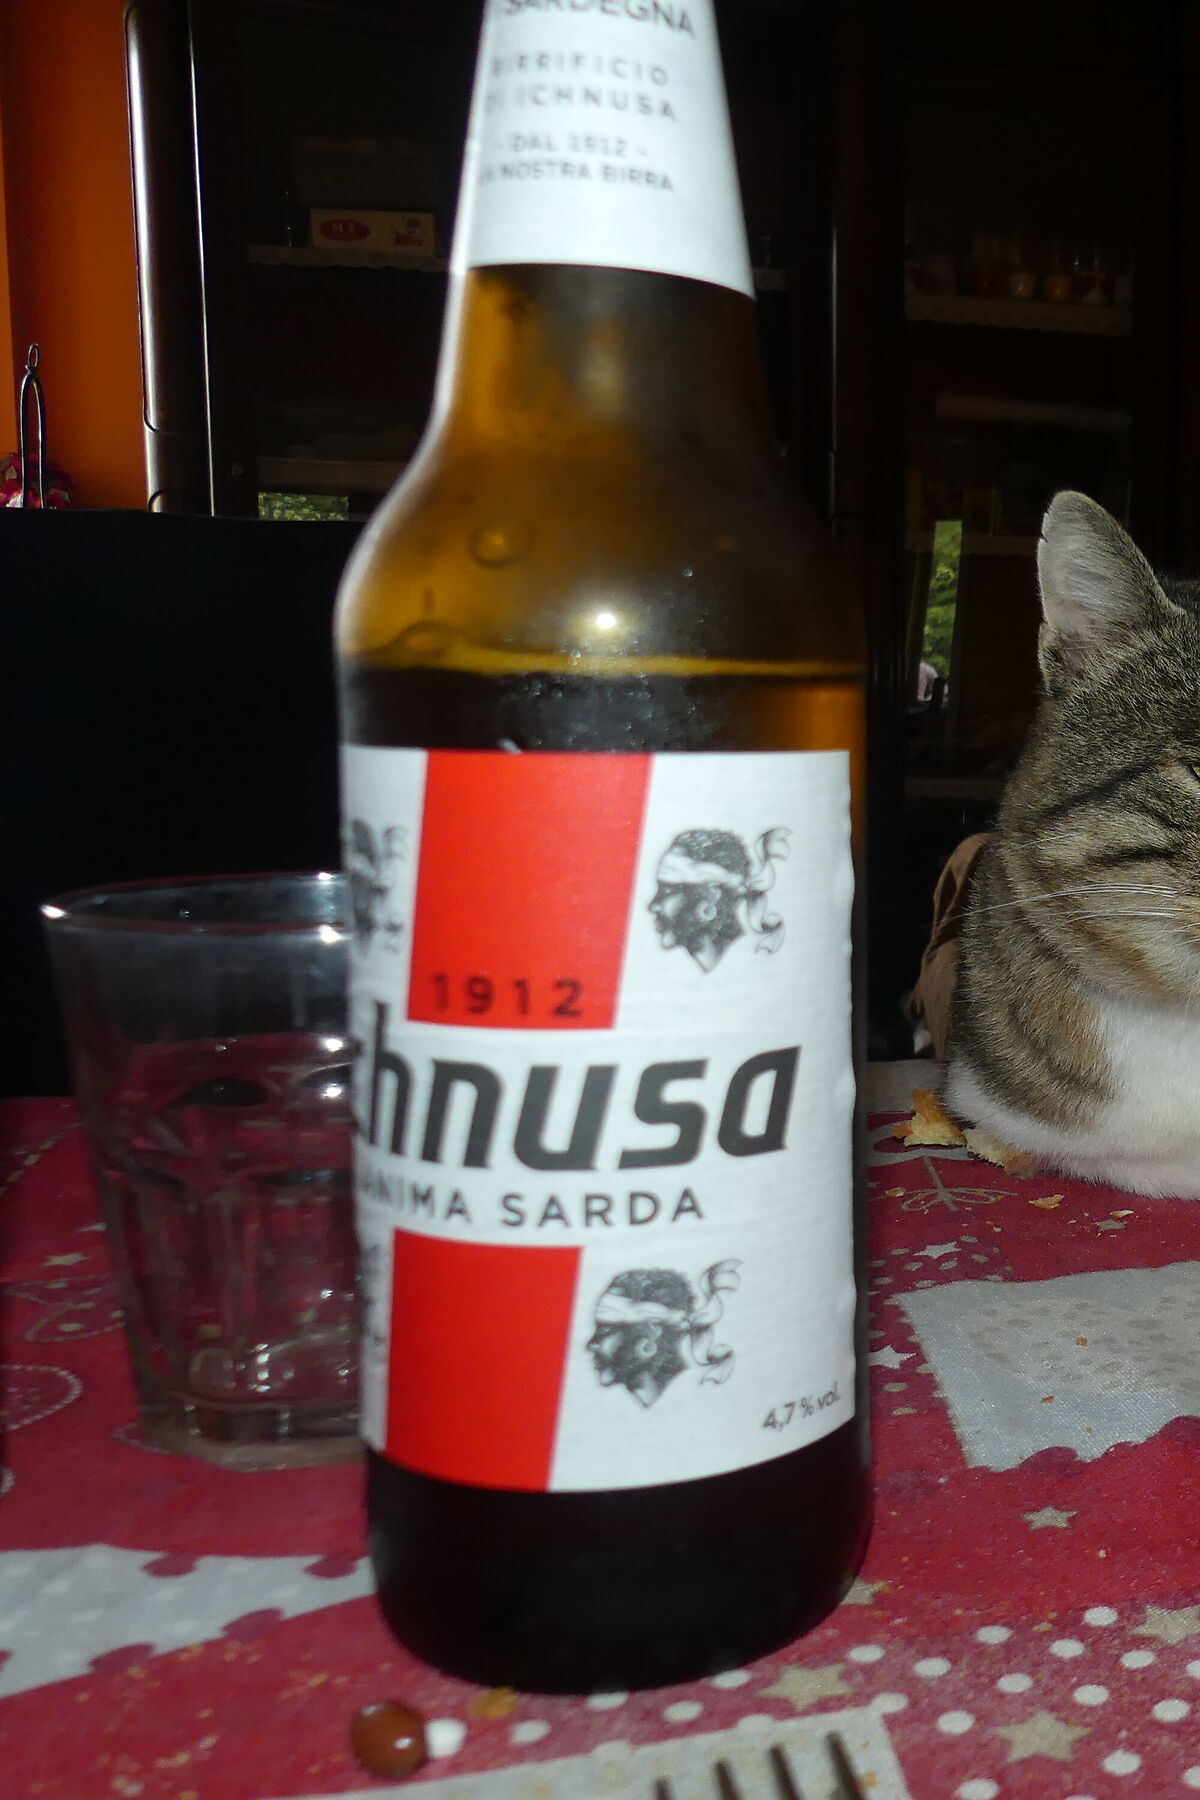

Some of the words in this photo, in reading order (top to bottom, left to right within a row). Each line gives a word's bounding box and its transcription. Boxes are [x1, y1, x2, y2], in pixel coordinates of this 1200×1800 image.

[513, 83, 677, 122] ICHNUSA
[510, 131, 557, 153] DAL
[568, 131, 629, 157] 1912
[498, 160, 592, 182] NOSTRA
[599, 163, 674, 192] BIRRA
[432, 973, 584, 1018] 1912
[362, 1000, 803, 1171] hnusa
[501, 1186, 705, 1228] SARDA
